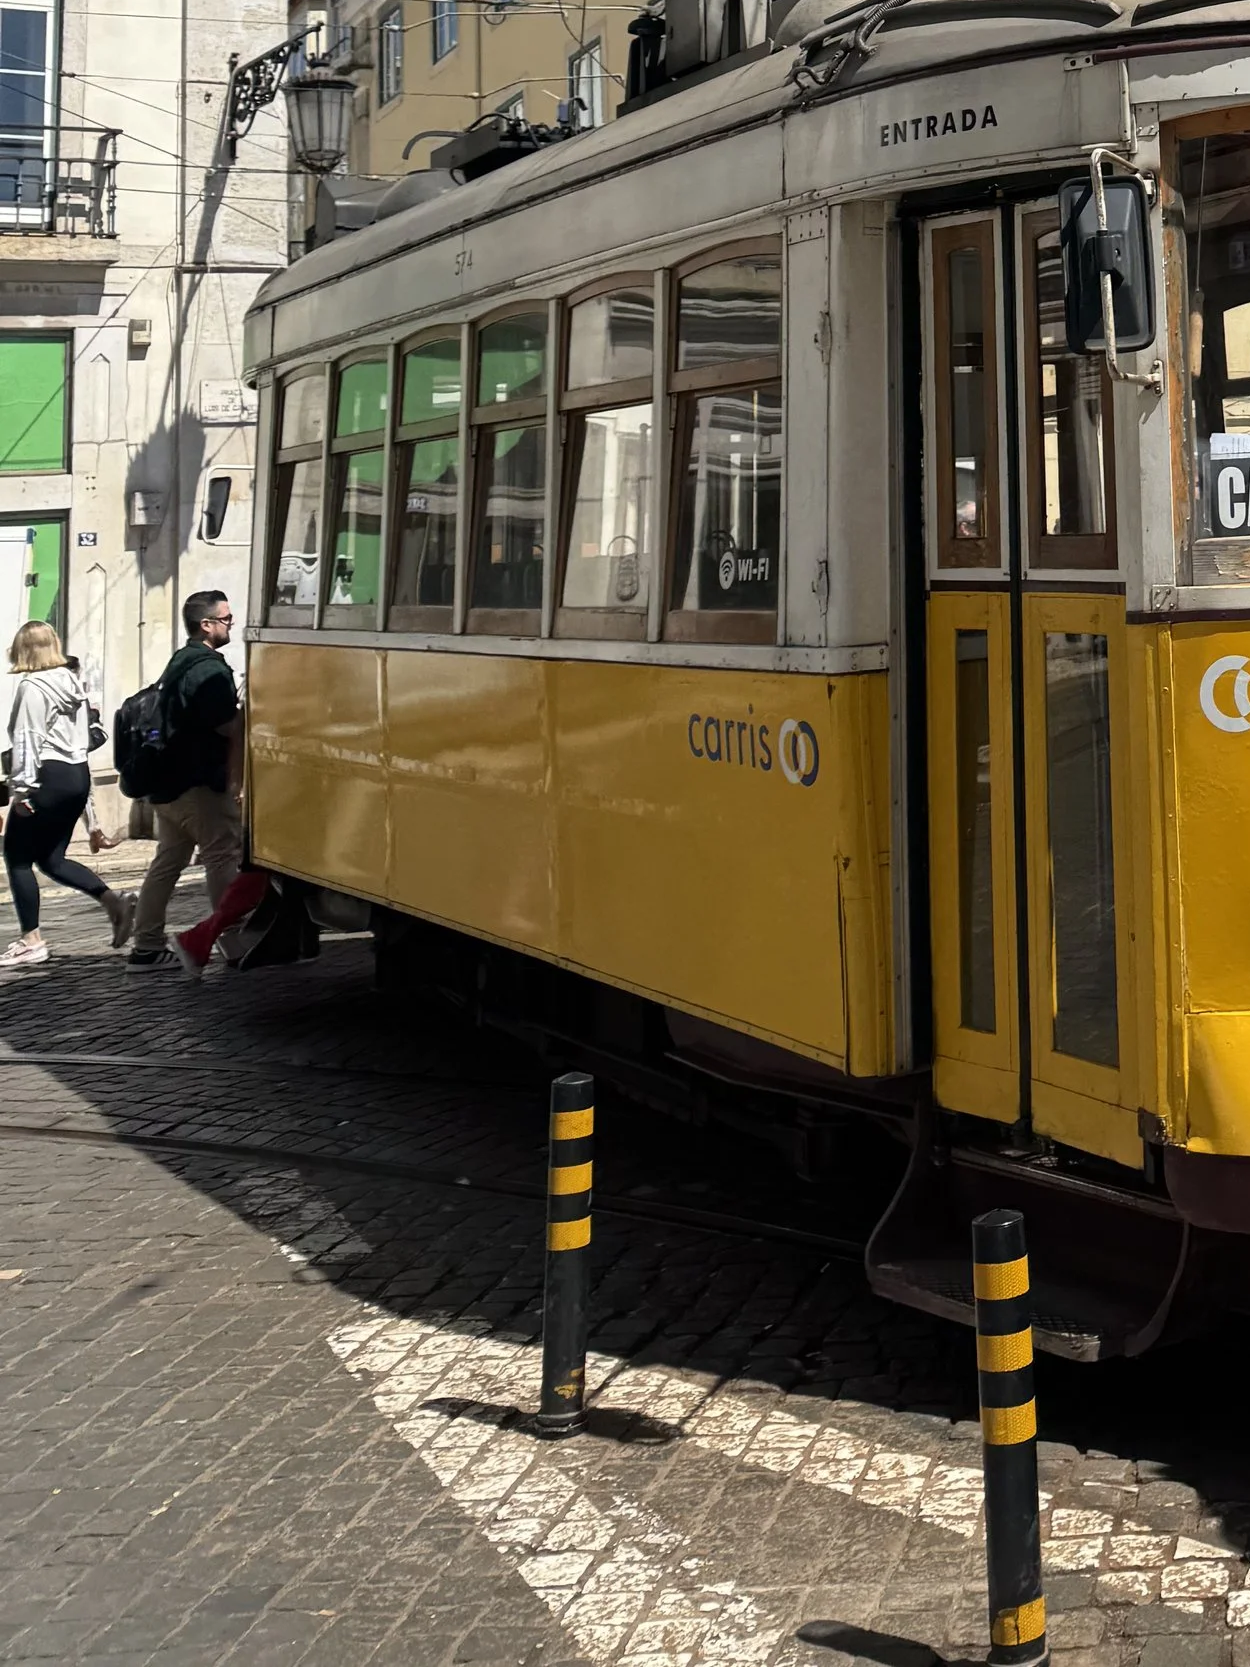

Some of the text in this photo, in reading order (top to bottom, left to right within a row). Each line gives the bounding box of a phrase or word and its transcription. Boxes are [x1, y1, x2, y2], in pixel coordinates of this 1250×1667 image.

[880, 105, 998, 147] ENTRADA
[454, 249, 473, 276] 574
[738, 557, 769, 582] WI-FI
[688, 703, 772, 771] carris
